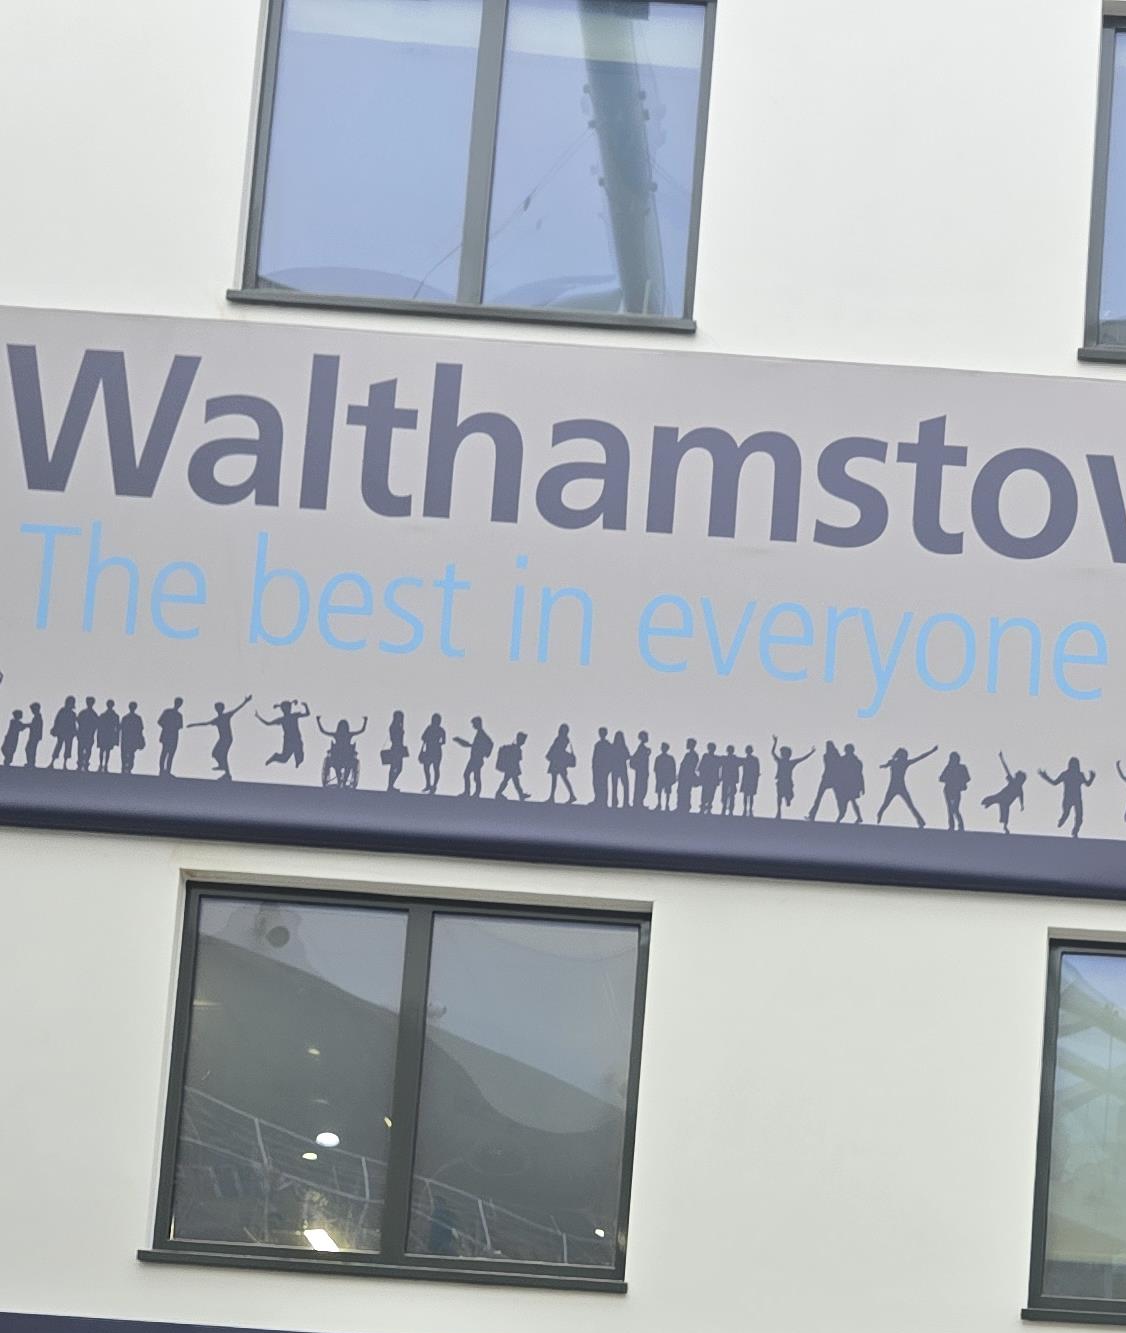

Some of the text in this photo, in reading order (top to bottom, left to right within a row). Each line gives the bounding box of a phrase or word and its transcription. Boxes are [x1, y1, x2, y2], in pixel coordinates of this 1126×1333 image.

[20, 519, 1109, 718] The best in everyone
